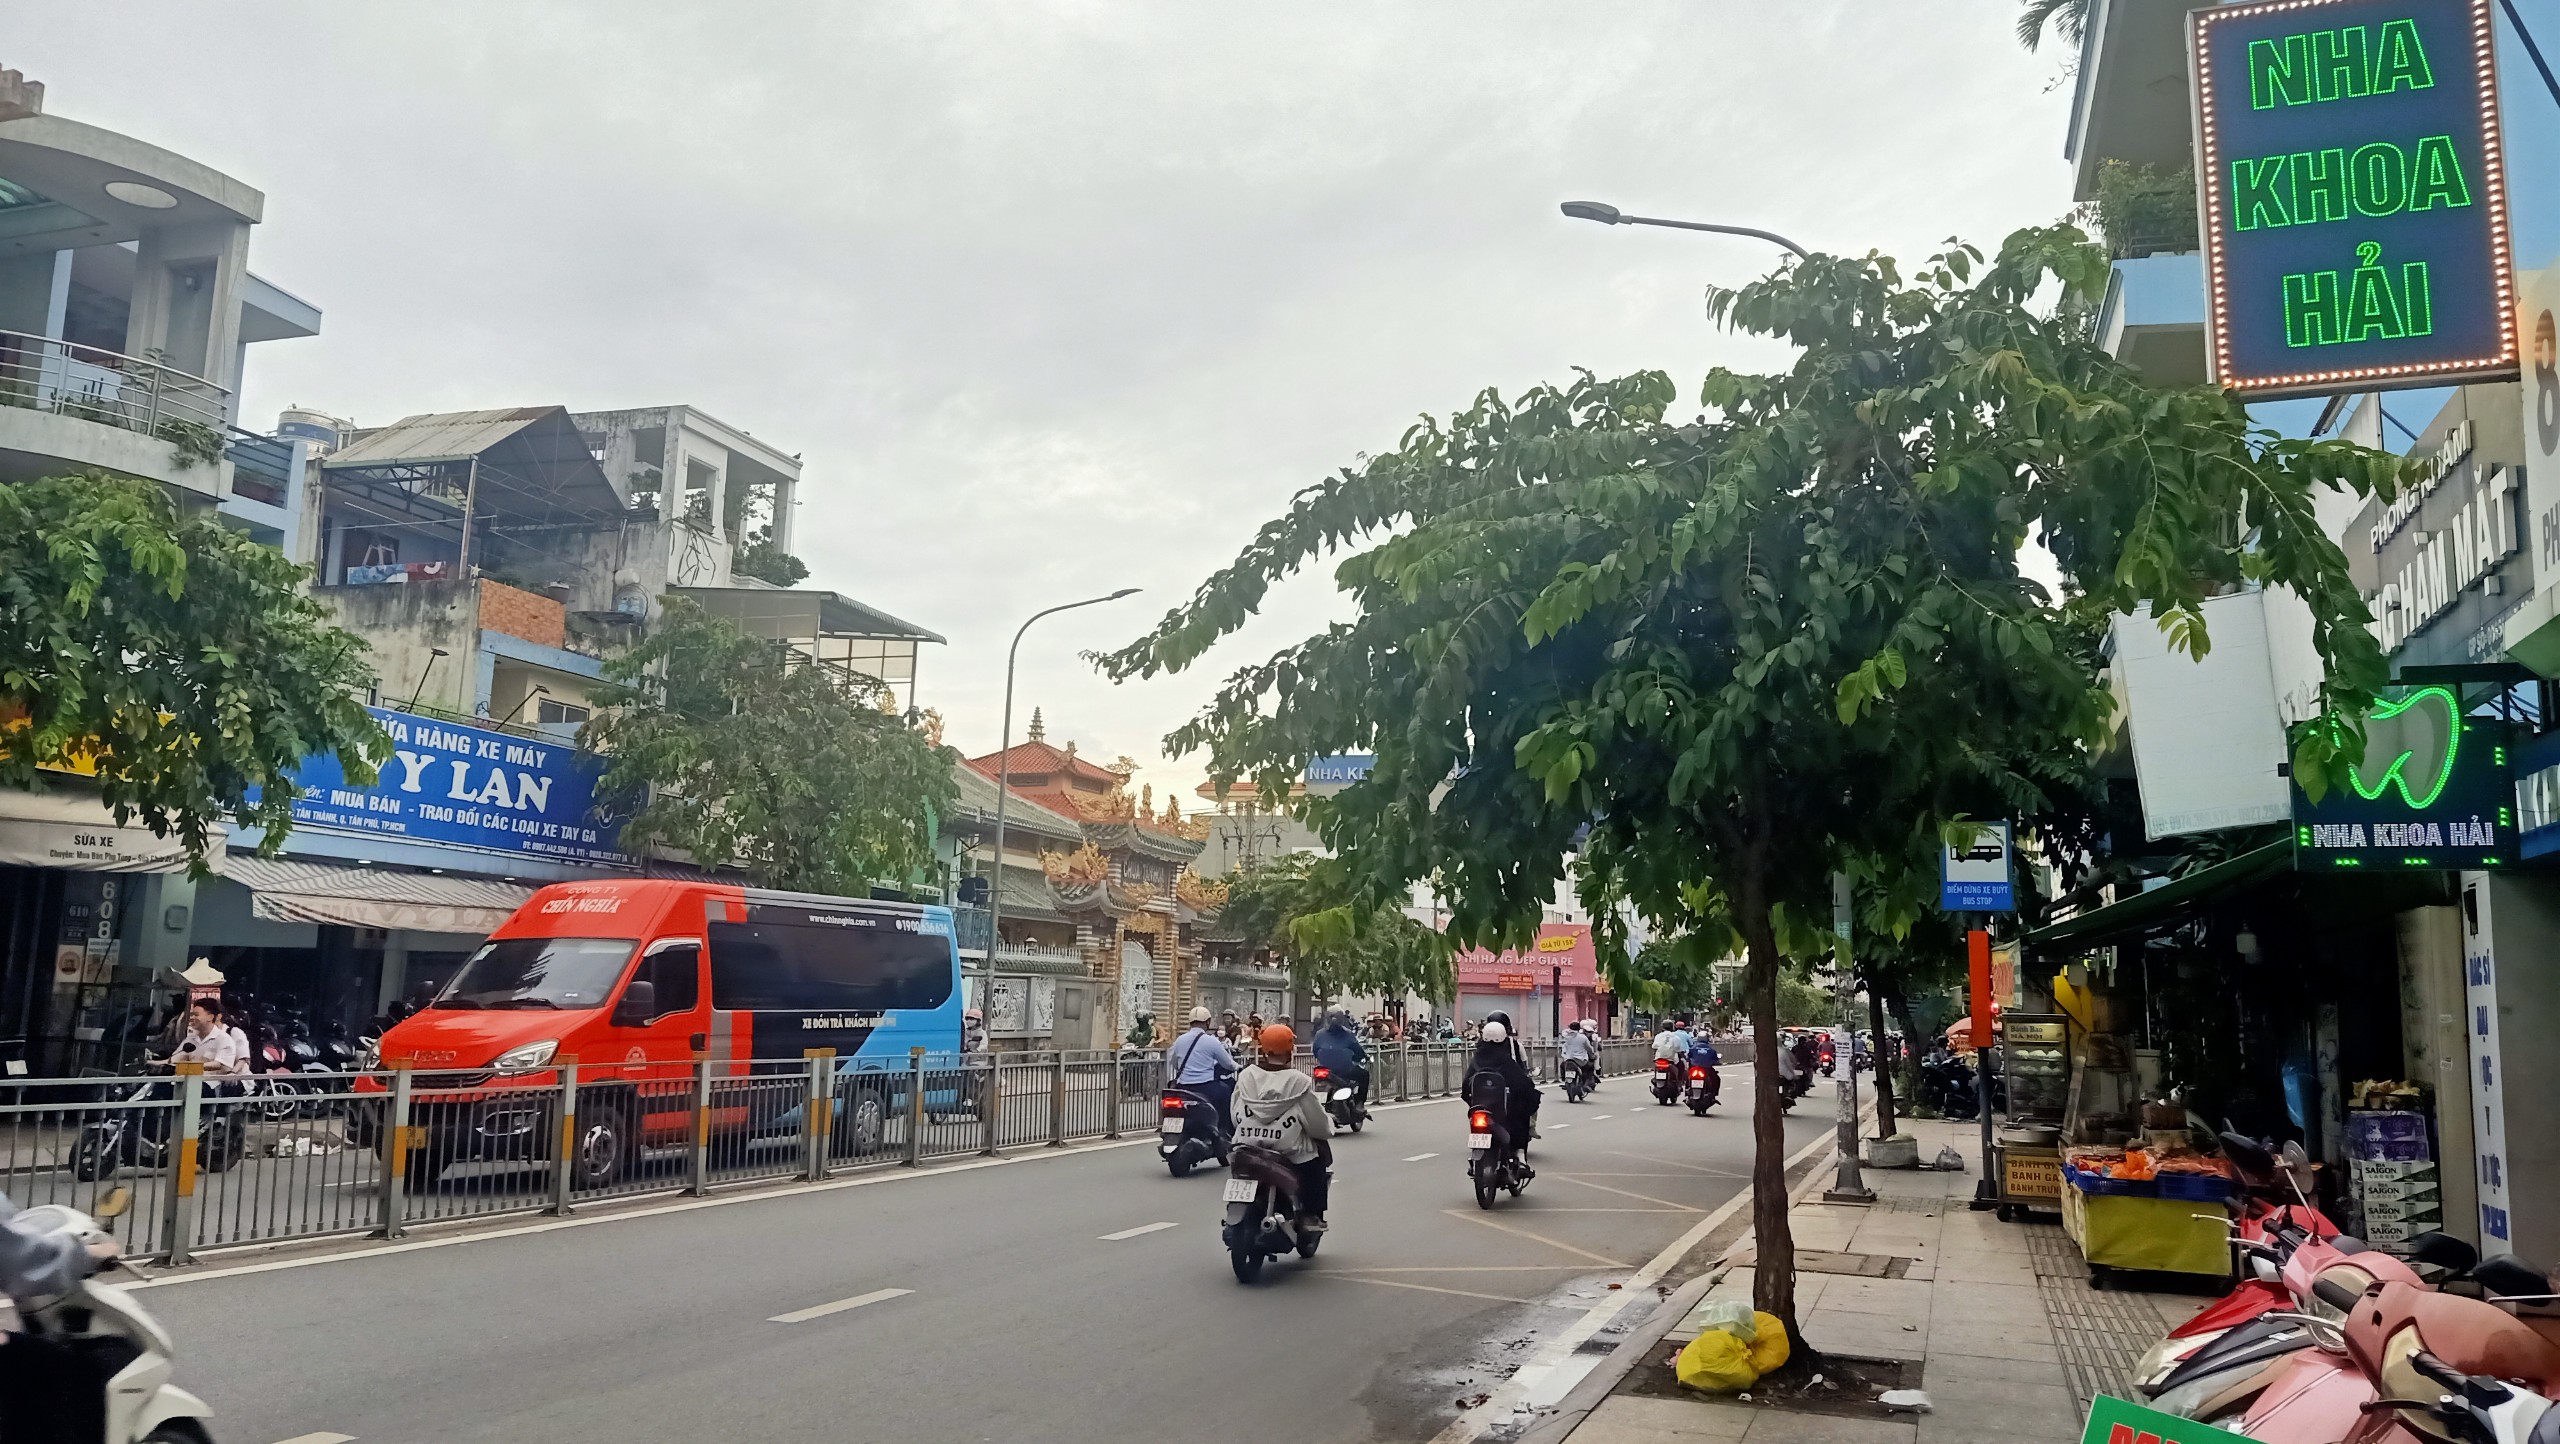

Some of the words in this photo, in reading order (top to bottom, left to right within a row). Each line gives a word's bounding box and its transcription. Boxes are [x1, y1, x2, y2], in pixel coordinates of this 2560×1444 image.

[2248, 18, 2435, 111] NHA
[2231, 134, 2473, 232] KHOA
[2282, 240, 2433, 349] HẢI
[2452, 464, 2510, 597] MẶT
[371, 713, 408, 743] ỬA
[414, 725, 471, 755] HÀNG
[475, 738, 502, 760] XE
[505, 743, 547, 769] MÁY
[1309, 766, 1343, 780] NHA
[446, 760, 553, 814] LAN
[329, 789, 365, 810] MUA
[368, 795, 400, 815] BÁN
[418, 803, 454, 823] TRAO
[456, 806, 480, 827] ĐỔI
[482, 812, 509, 831] CÁC
[511, 819, 539, 838] LOẠI
[541, 823, 558, 838] XE
[560, 825, 580, 842] TAY
[582, 828, 597, 844] GA
[74, 832, 96, 847] SỬA
[99, 836, 114, 848] XE
[2312, 823, 2368, 848] NHA
[2373, 822, 2443, 847] KHOA
[2449, 814, 2495, 847] HẢI
[567, 885, 602, 895] CÔNG
[603, 886, 621, 894] TY
[1982, 885, 1991, 894] XE
[541, 894, 579, 914] CHÍN
[1962, 896, 1976, 905] BUS
[1976, 896, 1993, 905] STOP
[452, 908, 504, 929] LA
[903, 919, 920, 932] 1900
[802, 1018, 813, 1029] XE
[813, 1013, 829, 1029] ĐÓN
[830, 1013, 844, 1029] TRẢ
[844, 1012, 869, 1028] KHÁCH
[2029, 1025, 2044, 1033] Bao
[1240, 1127, 1282, 1140] STUDIO
